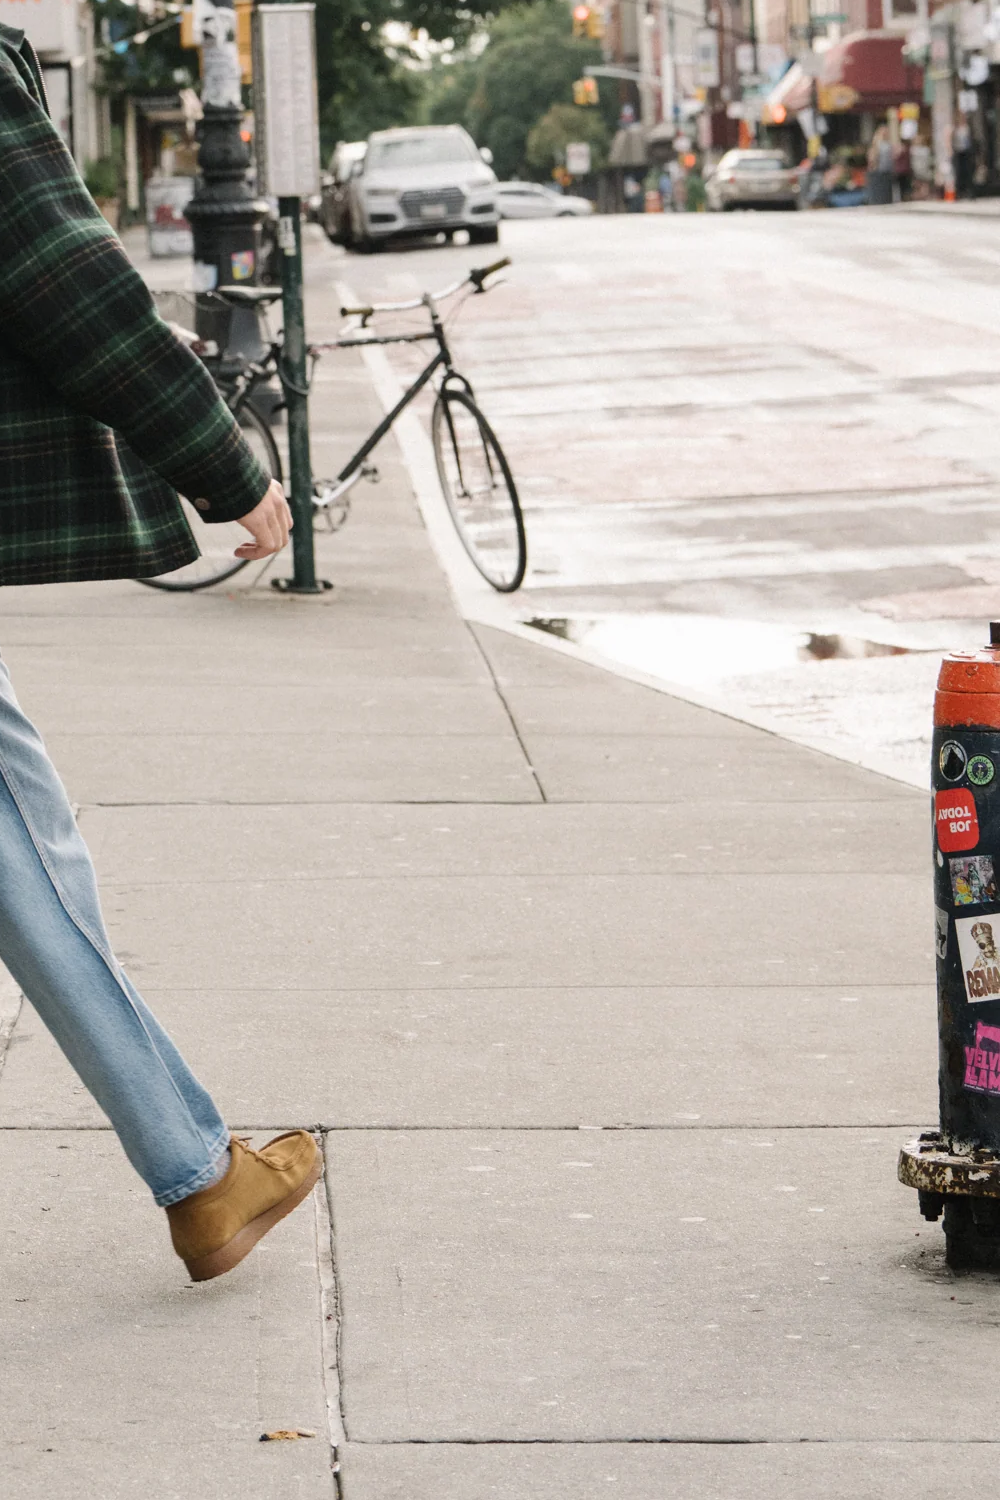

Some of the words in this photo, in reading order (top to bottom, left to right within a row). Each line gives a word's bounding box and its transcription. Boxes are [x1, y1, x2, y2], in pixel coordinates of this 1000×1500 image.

[938, 805, 971, 820] TODAY
[949, 820, 971, 833] JOB
[965, 1046, 1000, 1071] VELV
